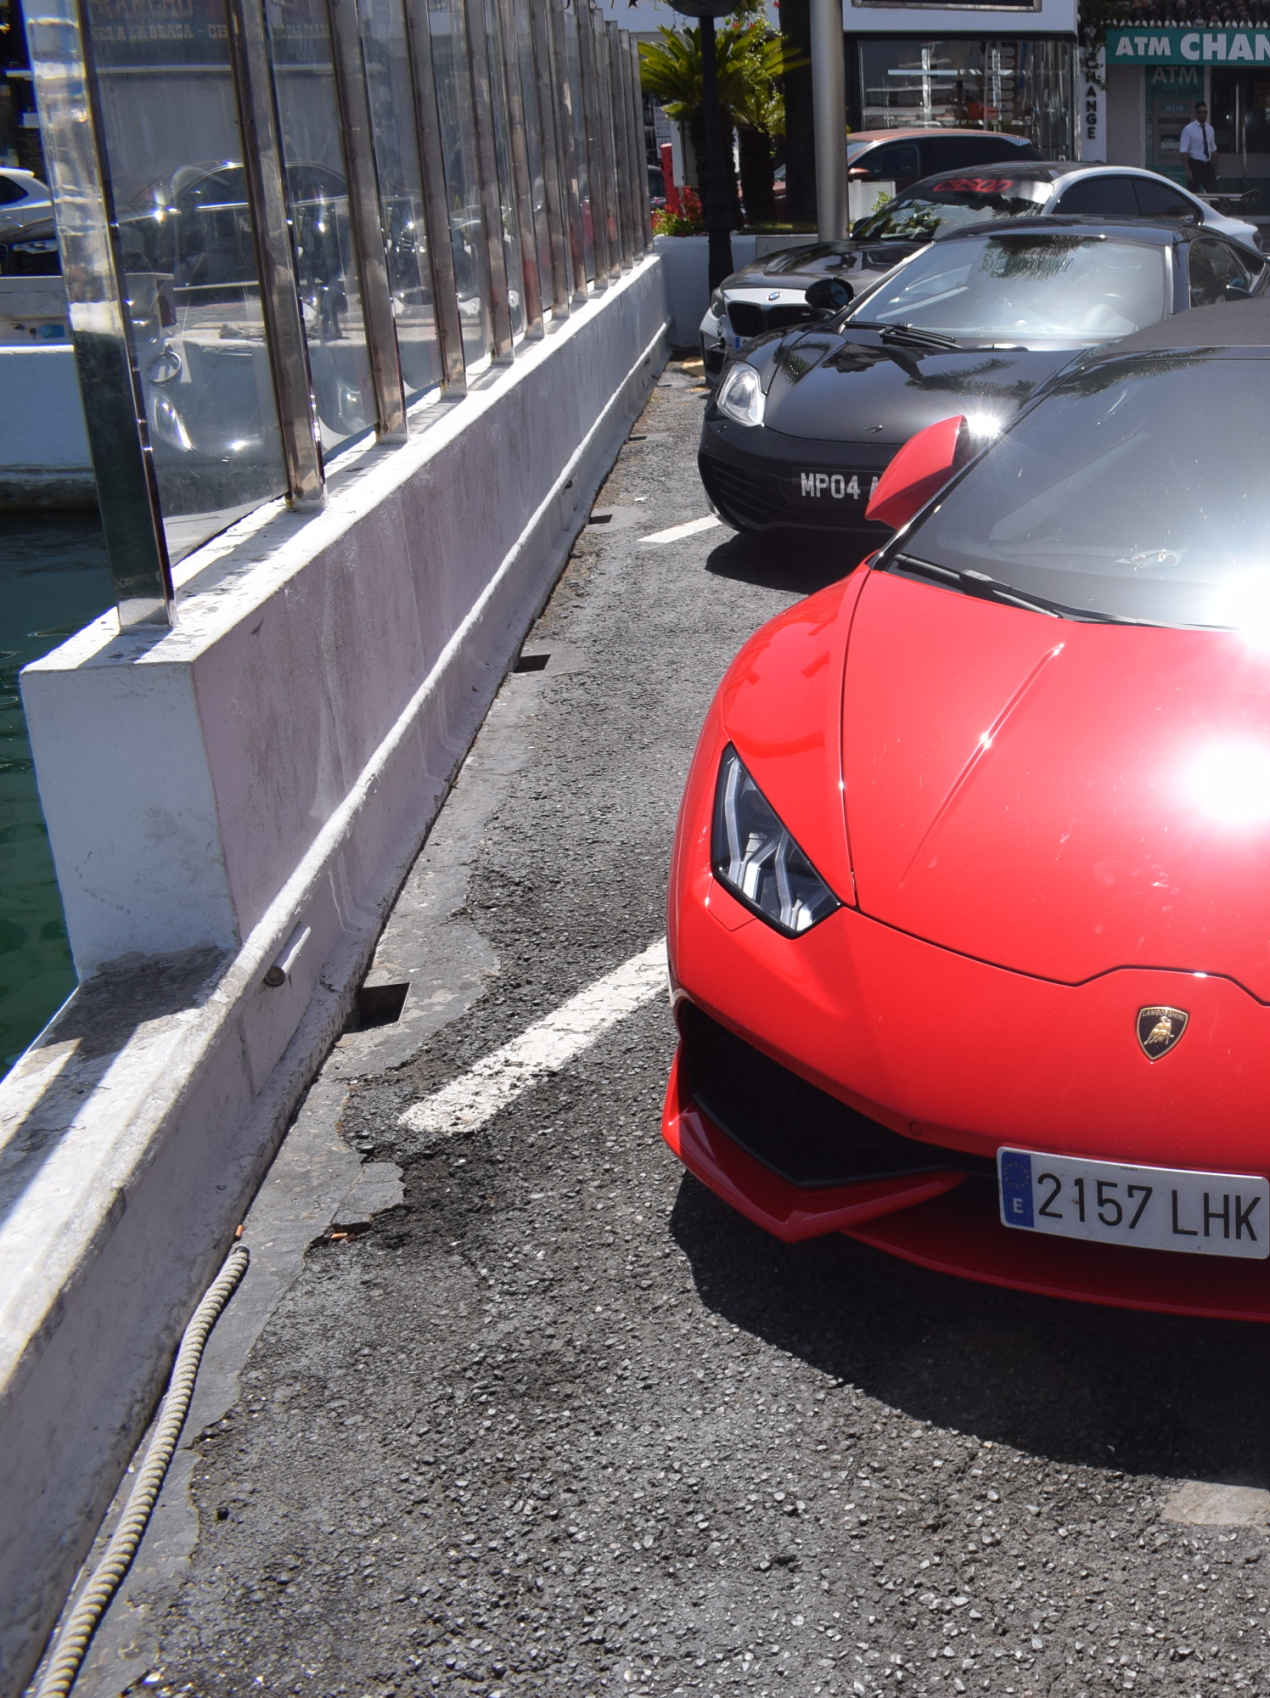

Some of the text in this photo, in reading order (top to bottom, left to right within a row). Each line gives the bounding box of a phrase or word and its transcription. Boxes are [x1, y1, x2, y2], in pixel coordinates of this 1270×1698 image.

[1115, 37, 1171, 56] ATM
[1151, 66, 1199, 84] ATM
[1142, 1009, 1186, 1022] LAMBORGHINI
[1013, 1173, 1262, 1242] E 2157 LHK
